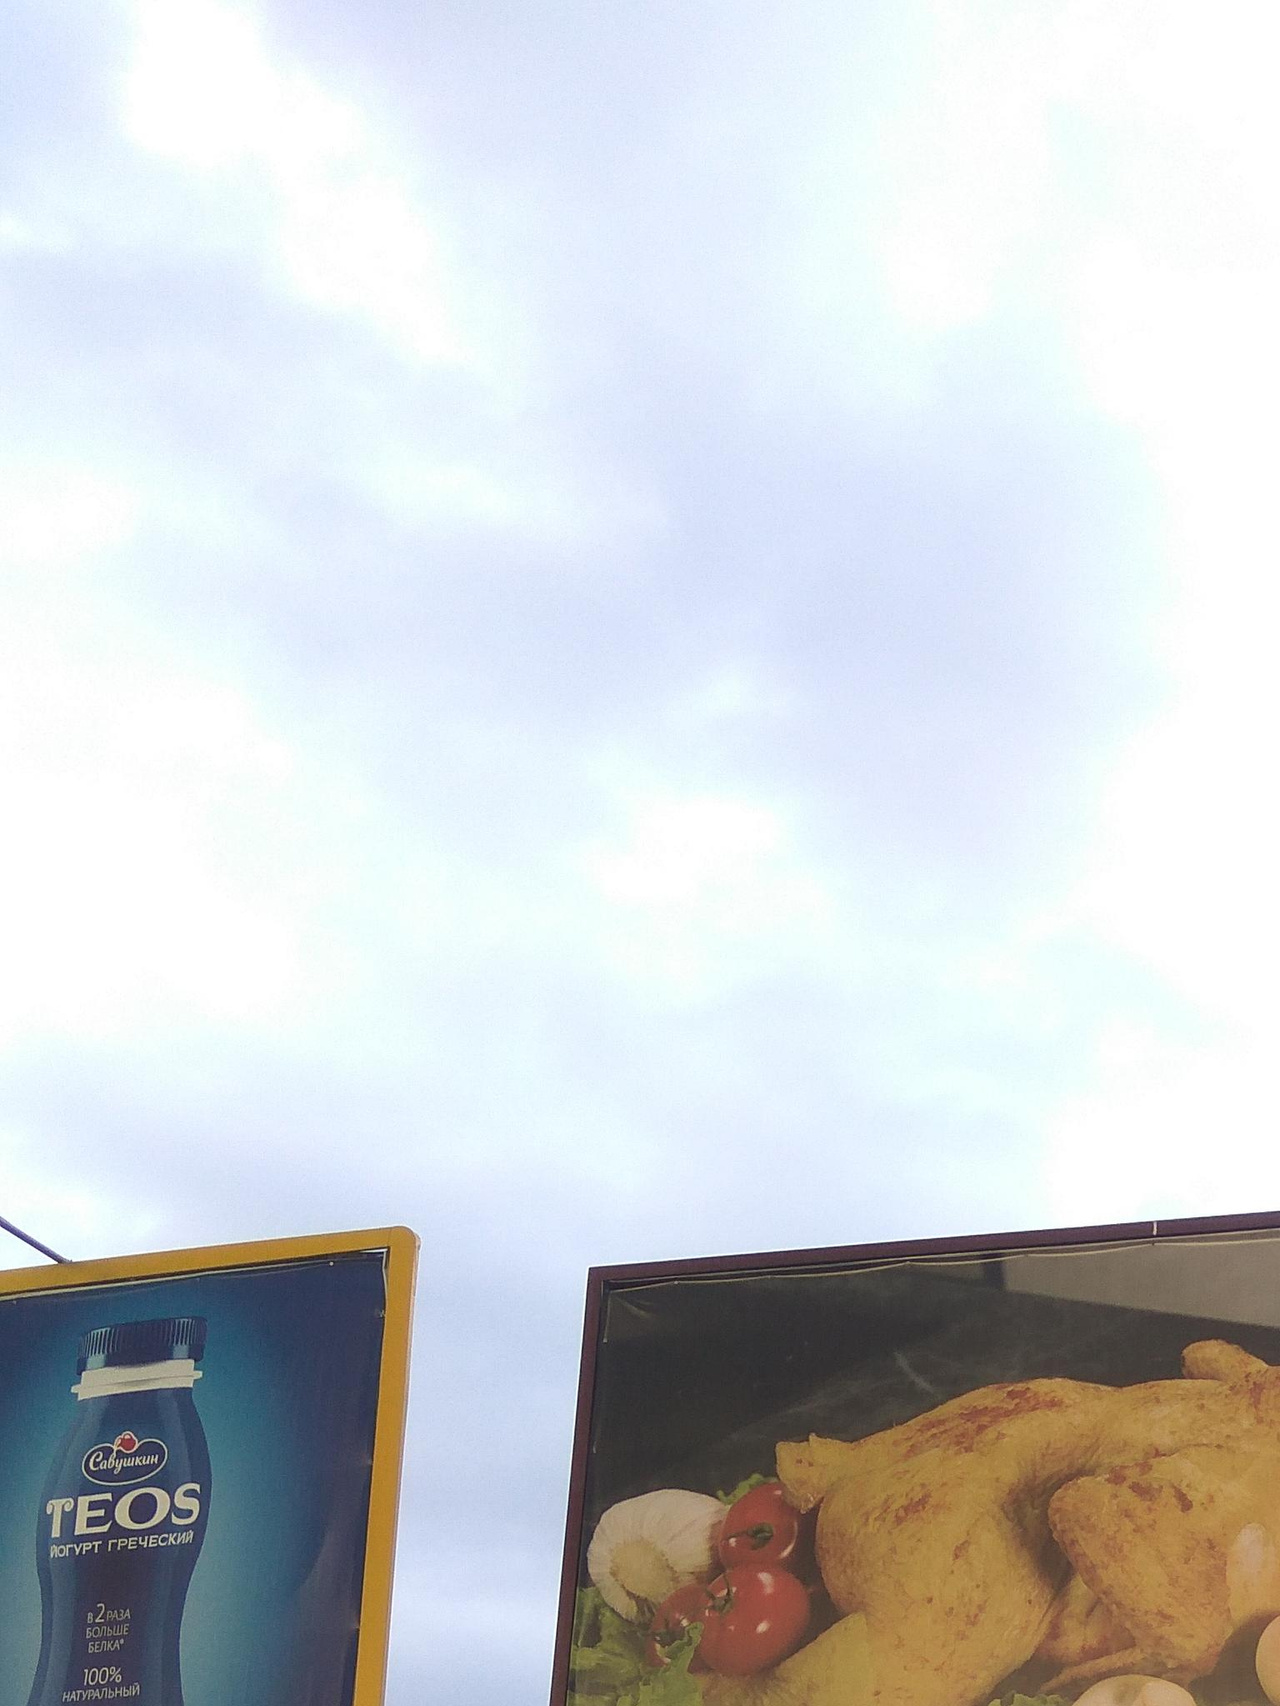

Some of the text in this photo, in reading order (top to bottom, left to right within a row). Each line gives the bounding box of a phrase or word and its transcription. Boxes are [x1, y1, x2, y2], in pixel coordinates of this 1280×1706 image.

[88, 1449, 159, 1475] Савушкин
[45, 1482, 201, 1539] TEOS
[50, 1529, 194, 1559] ЙОГУРТ ГРЕЧЕСКИЙ
[94, 1603, 106, 1623] 2
[106, 1608, 131, 1622] РАЗА
[85, 1623, 130, 1639] БОЛЬШЕ
[83, 1666, 122, 1686] 100%
[62, 1682, 141, 1703] НАТУРАЛЬНЫЙ
